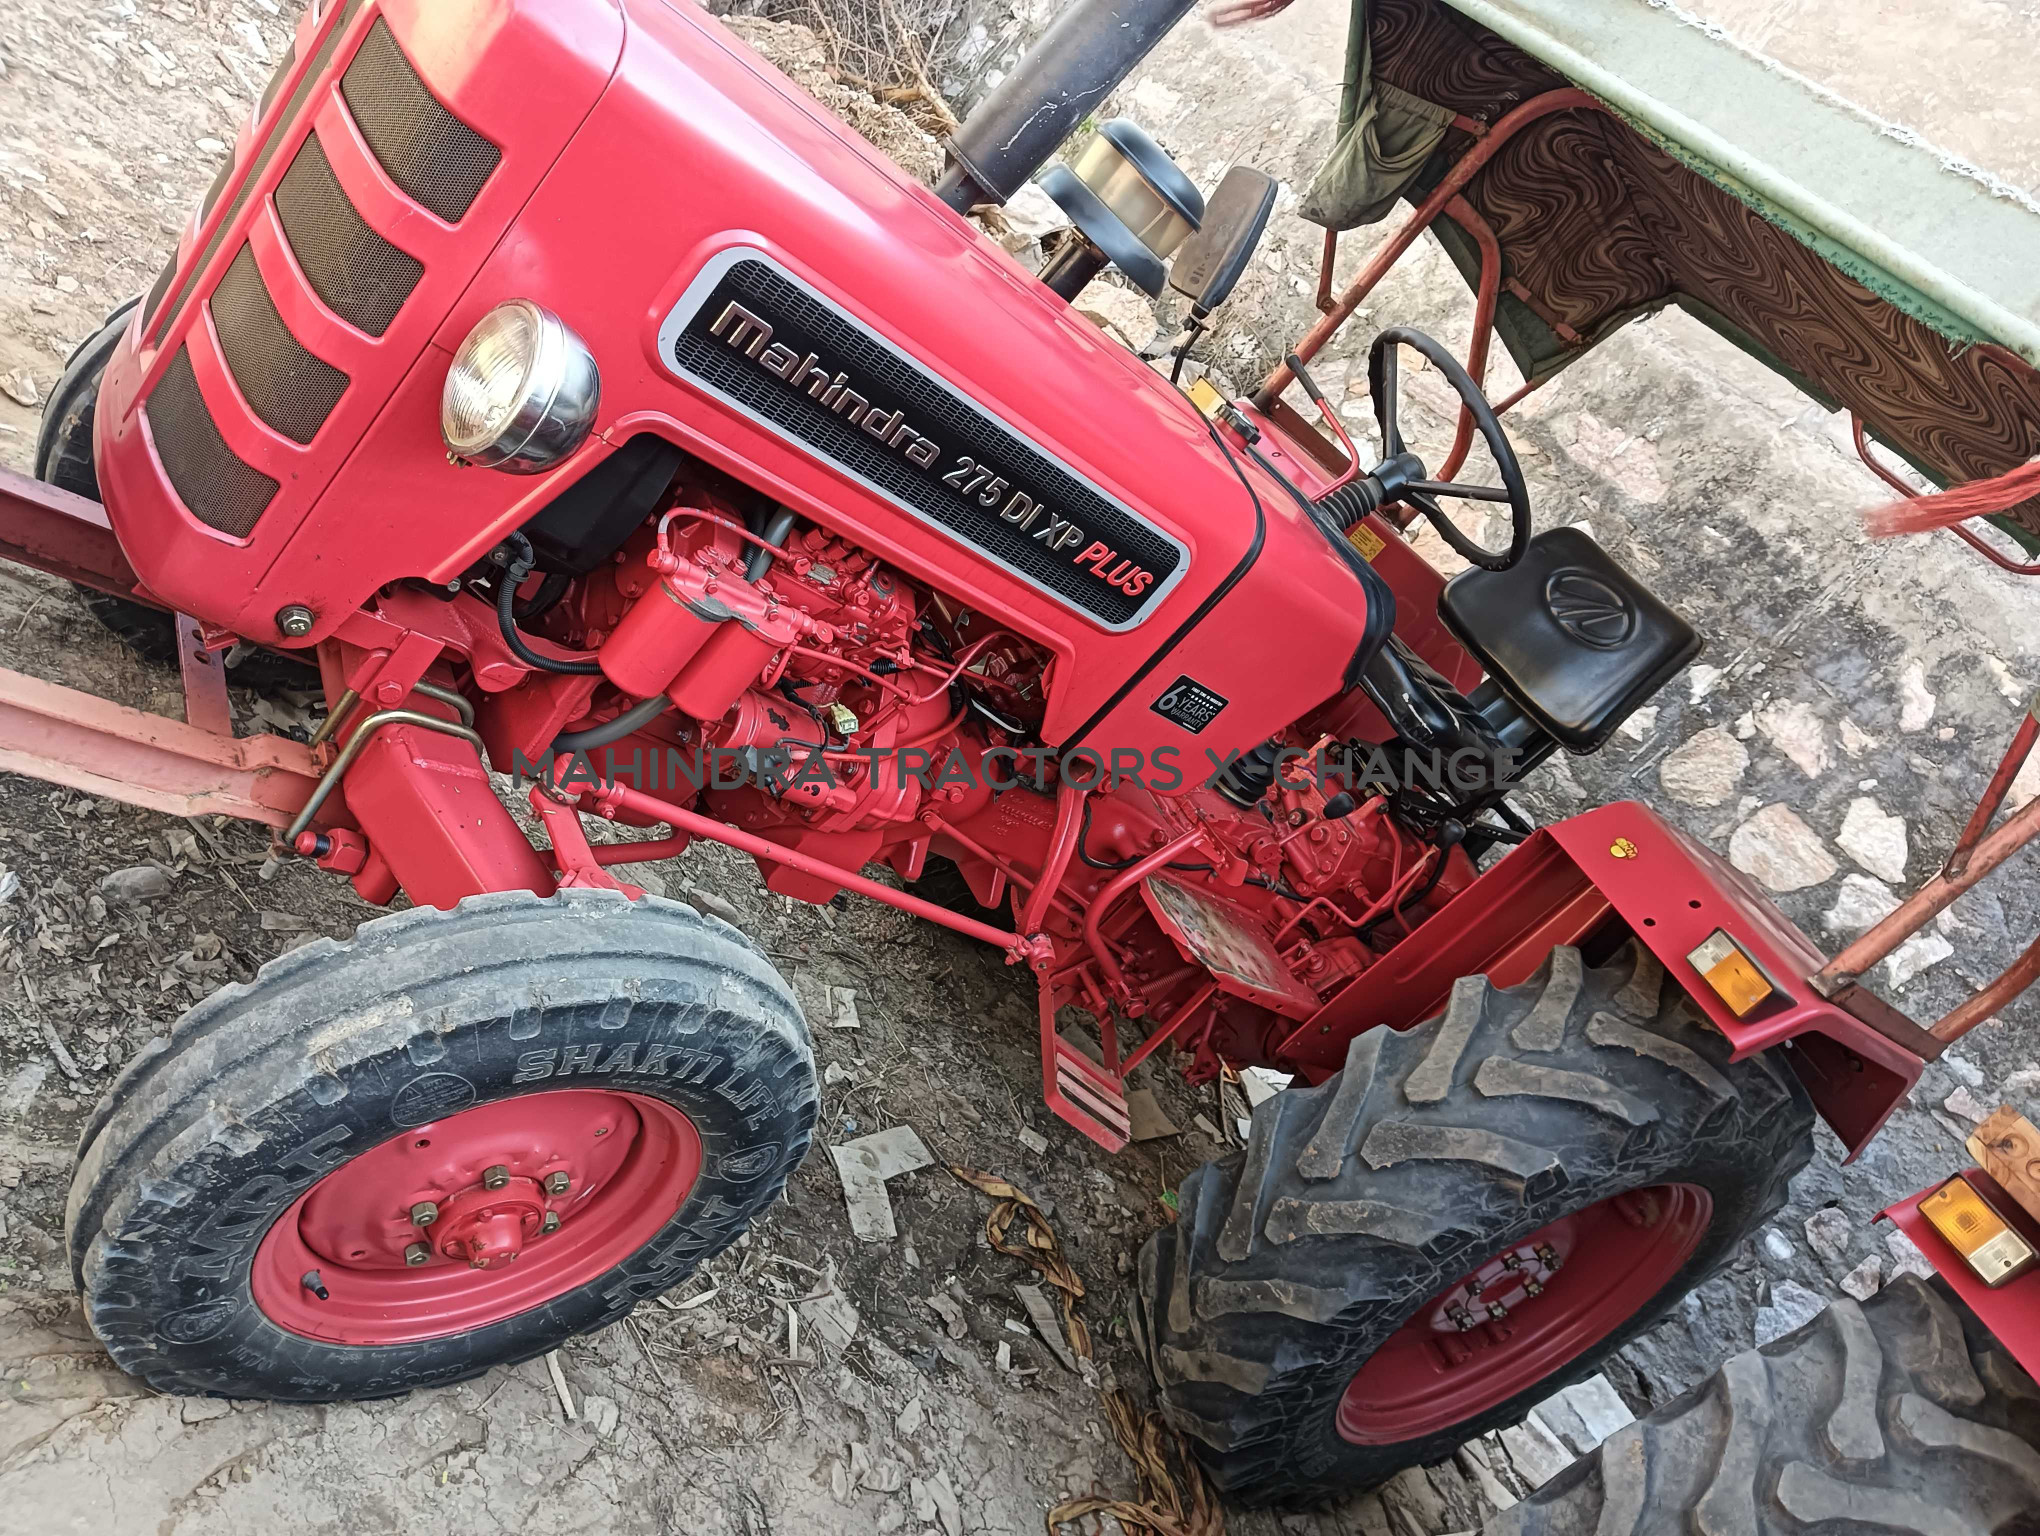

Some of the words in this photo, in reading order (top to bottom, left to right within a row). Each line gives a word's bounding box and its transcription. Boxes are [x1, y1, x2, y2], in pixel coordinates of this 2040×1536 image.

[709, 300, 941, 469] Mahindra
[942, 456, 1010, 508] 275
[1000, 490, 1045, 533] DI
[1033, 513, 1085, 553] XP
[1073, 541, 1154, 599] PLUS
[1158, 685, 1187, 710] 6
[1170, 707, 1203, 728] WARRANTY
[512, 1042, 724, 1085] SHAKTI
[713, 1066, 785, 1132] LIFE
[170, 1122, 354, 1284] MRF
